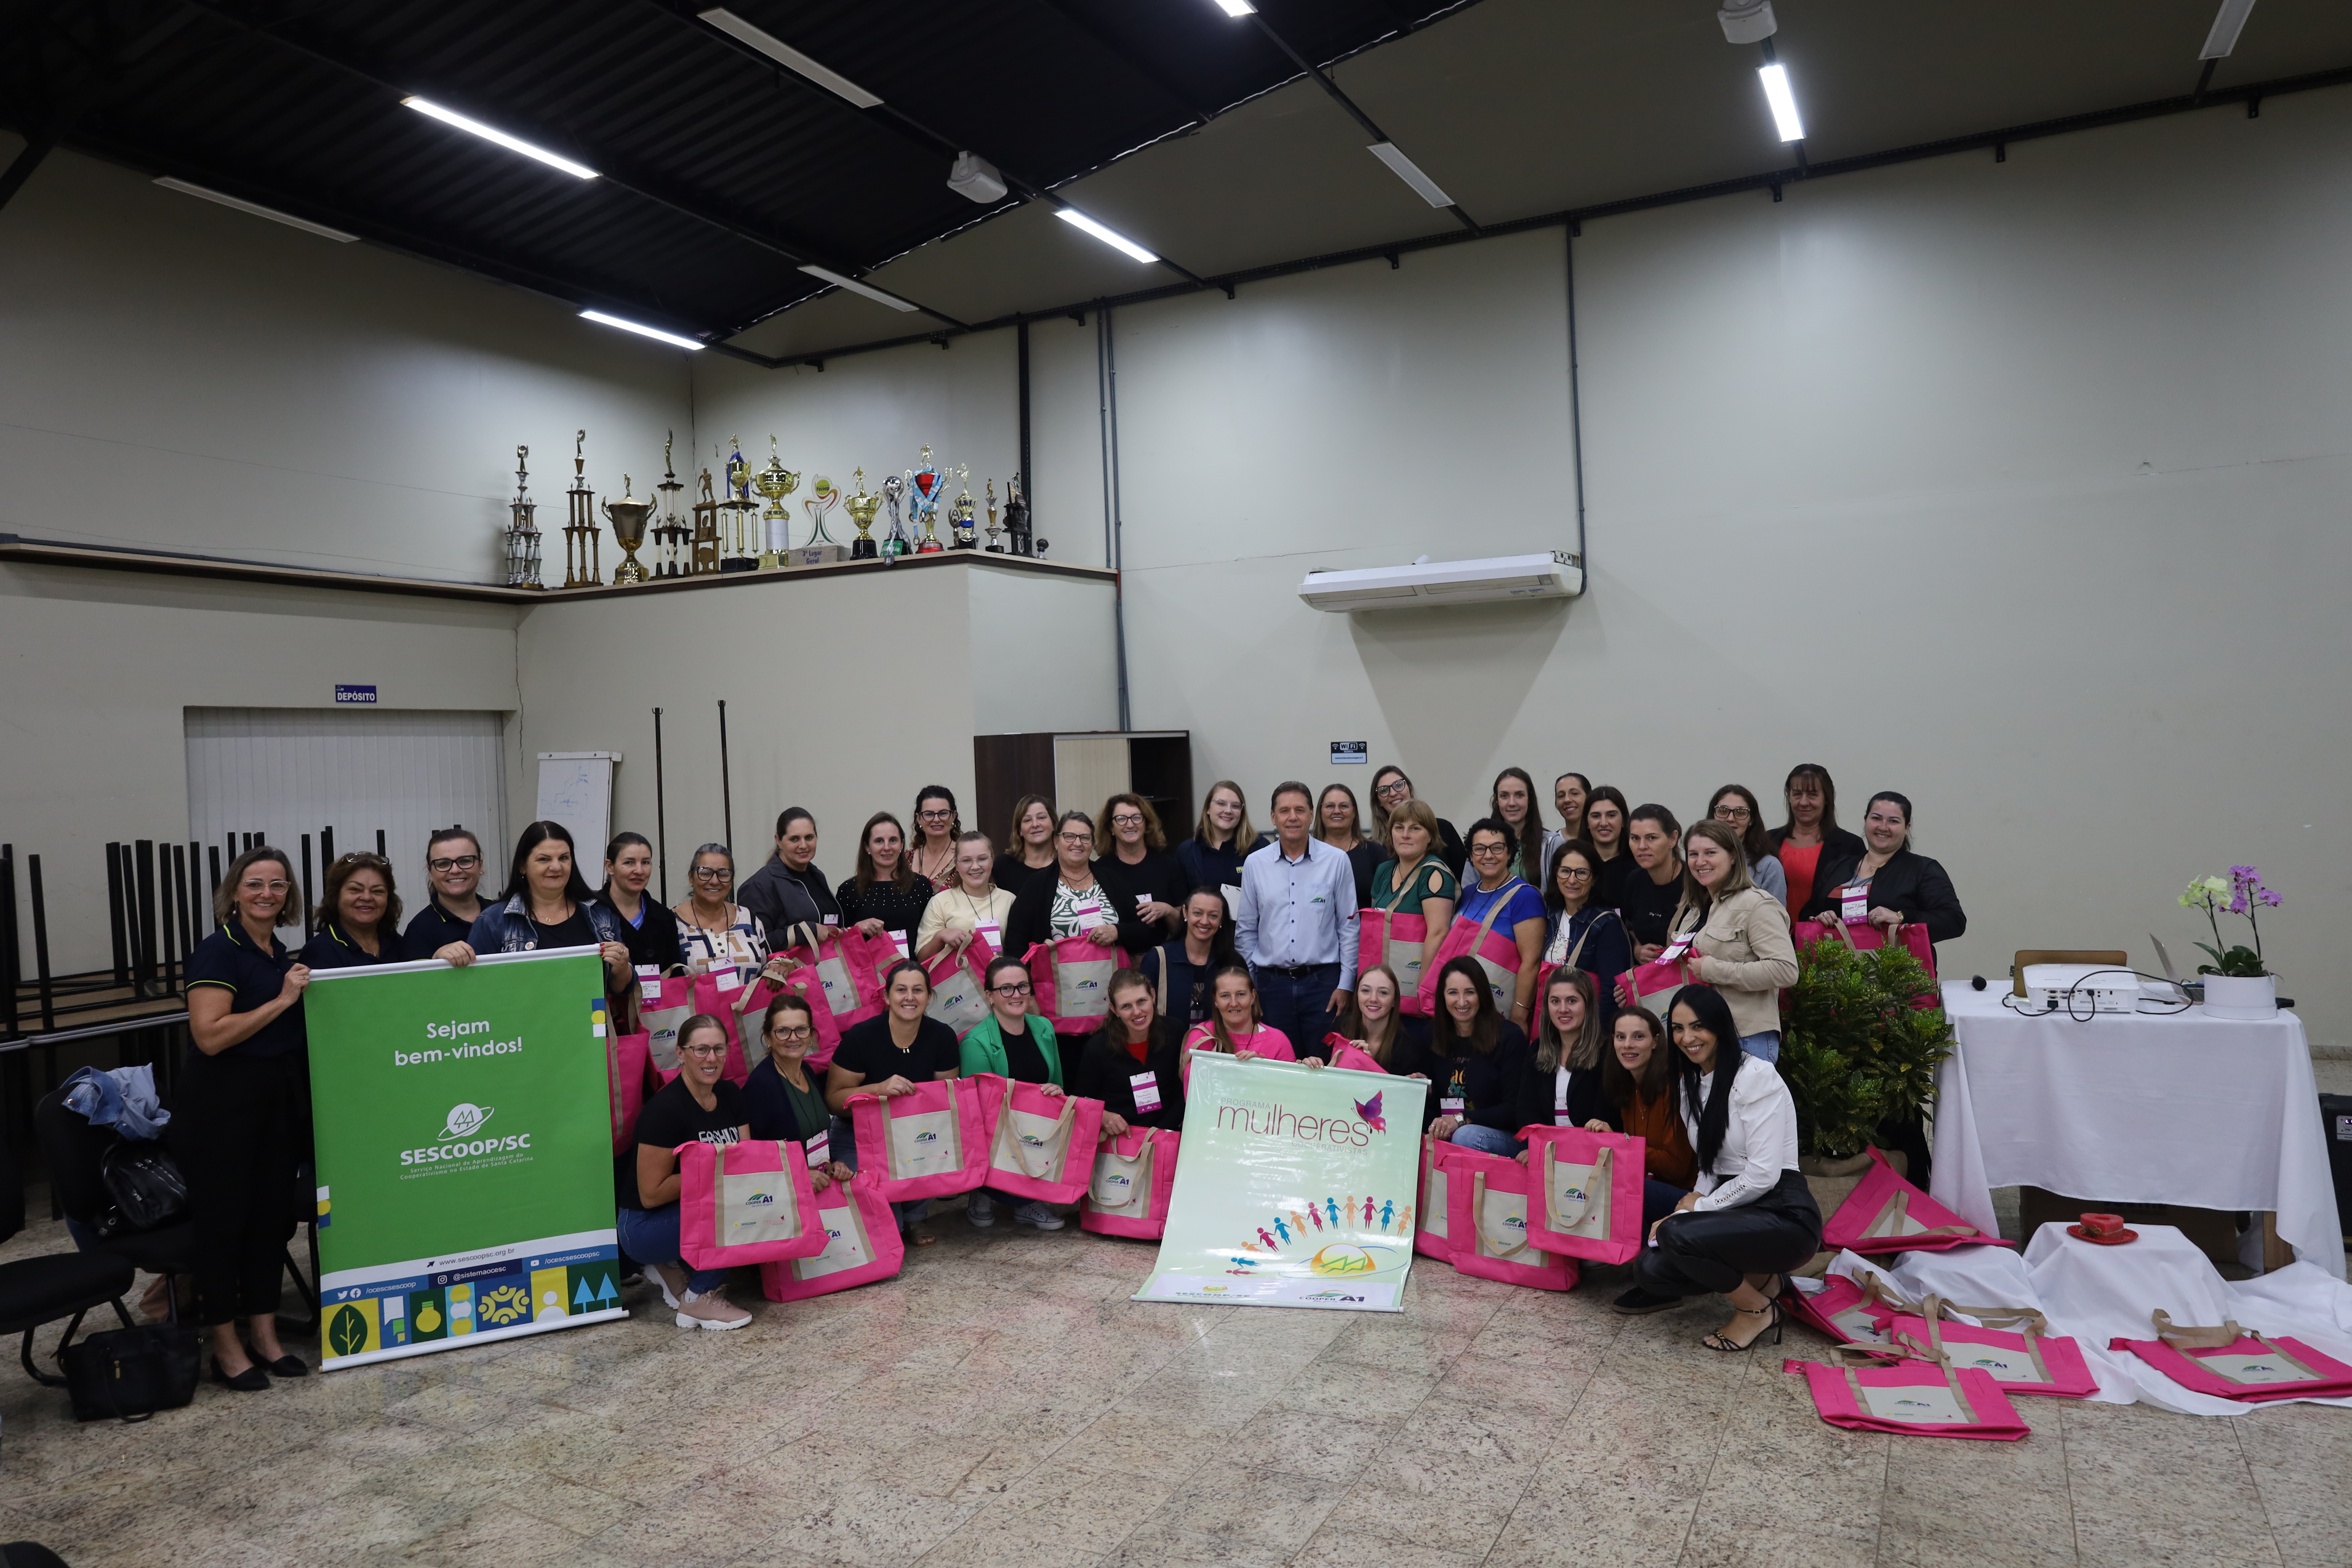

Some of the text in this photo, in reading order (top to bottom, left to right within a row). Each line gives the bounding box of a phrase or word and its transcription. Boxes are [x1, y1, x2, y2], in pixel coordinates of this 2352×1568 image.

[337, 691, 375, 701] DEPÓSITO
[955, 995, 963, 1003] A1
[427, 1020, 490, 1040] Sejam
[395, 1036, 523, 1066] bem-vindos!
[1221, 1097, 1270, 1109] PROGRAMA
[1217, 1104, 1369, 1146] mulheres
[400, 1134, 530, 1165] SESCOOP/SC
[1292, 1140, 1368, 1155] COOPERATIVISTAS
[435, 1162, 461, 1170] Nacional
[473, 1154, 514, 1165] Aprendizagem
[400, 1170, 447, 1179] Cooperativismo
[762, 1195, 773, 1204] A1
[1576, 1192, 1586, 1200] A1
[439, 1248, 515, 1266] www.sescoopsc.org.br
[544, 1250, 600, 1265] /ocescsescoopsc
[453, 1265, 507, 1281] @sistemaocesc
[366, 1280, 416, 1294] /ocescsescoop
